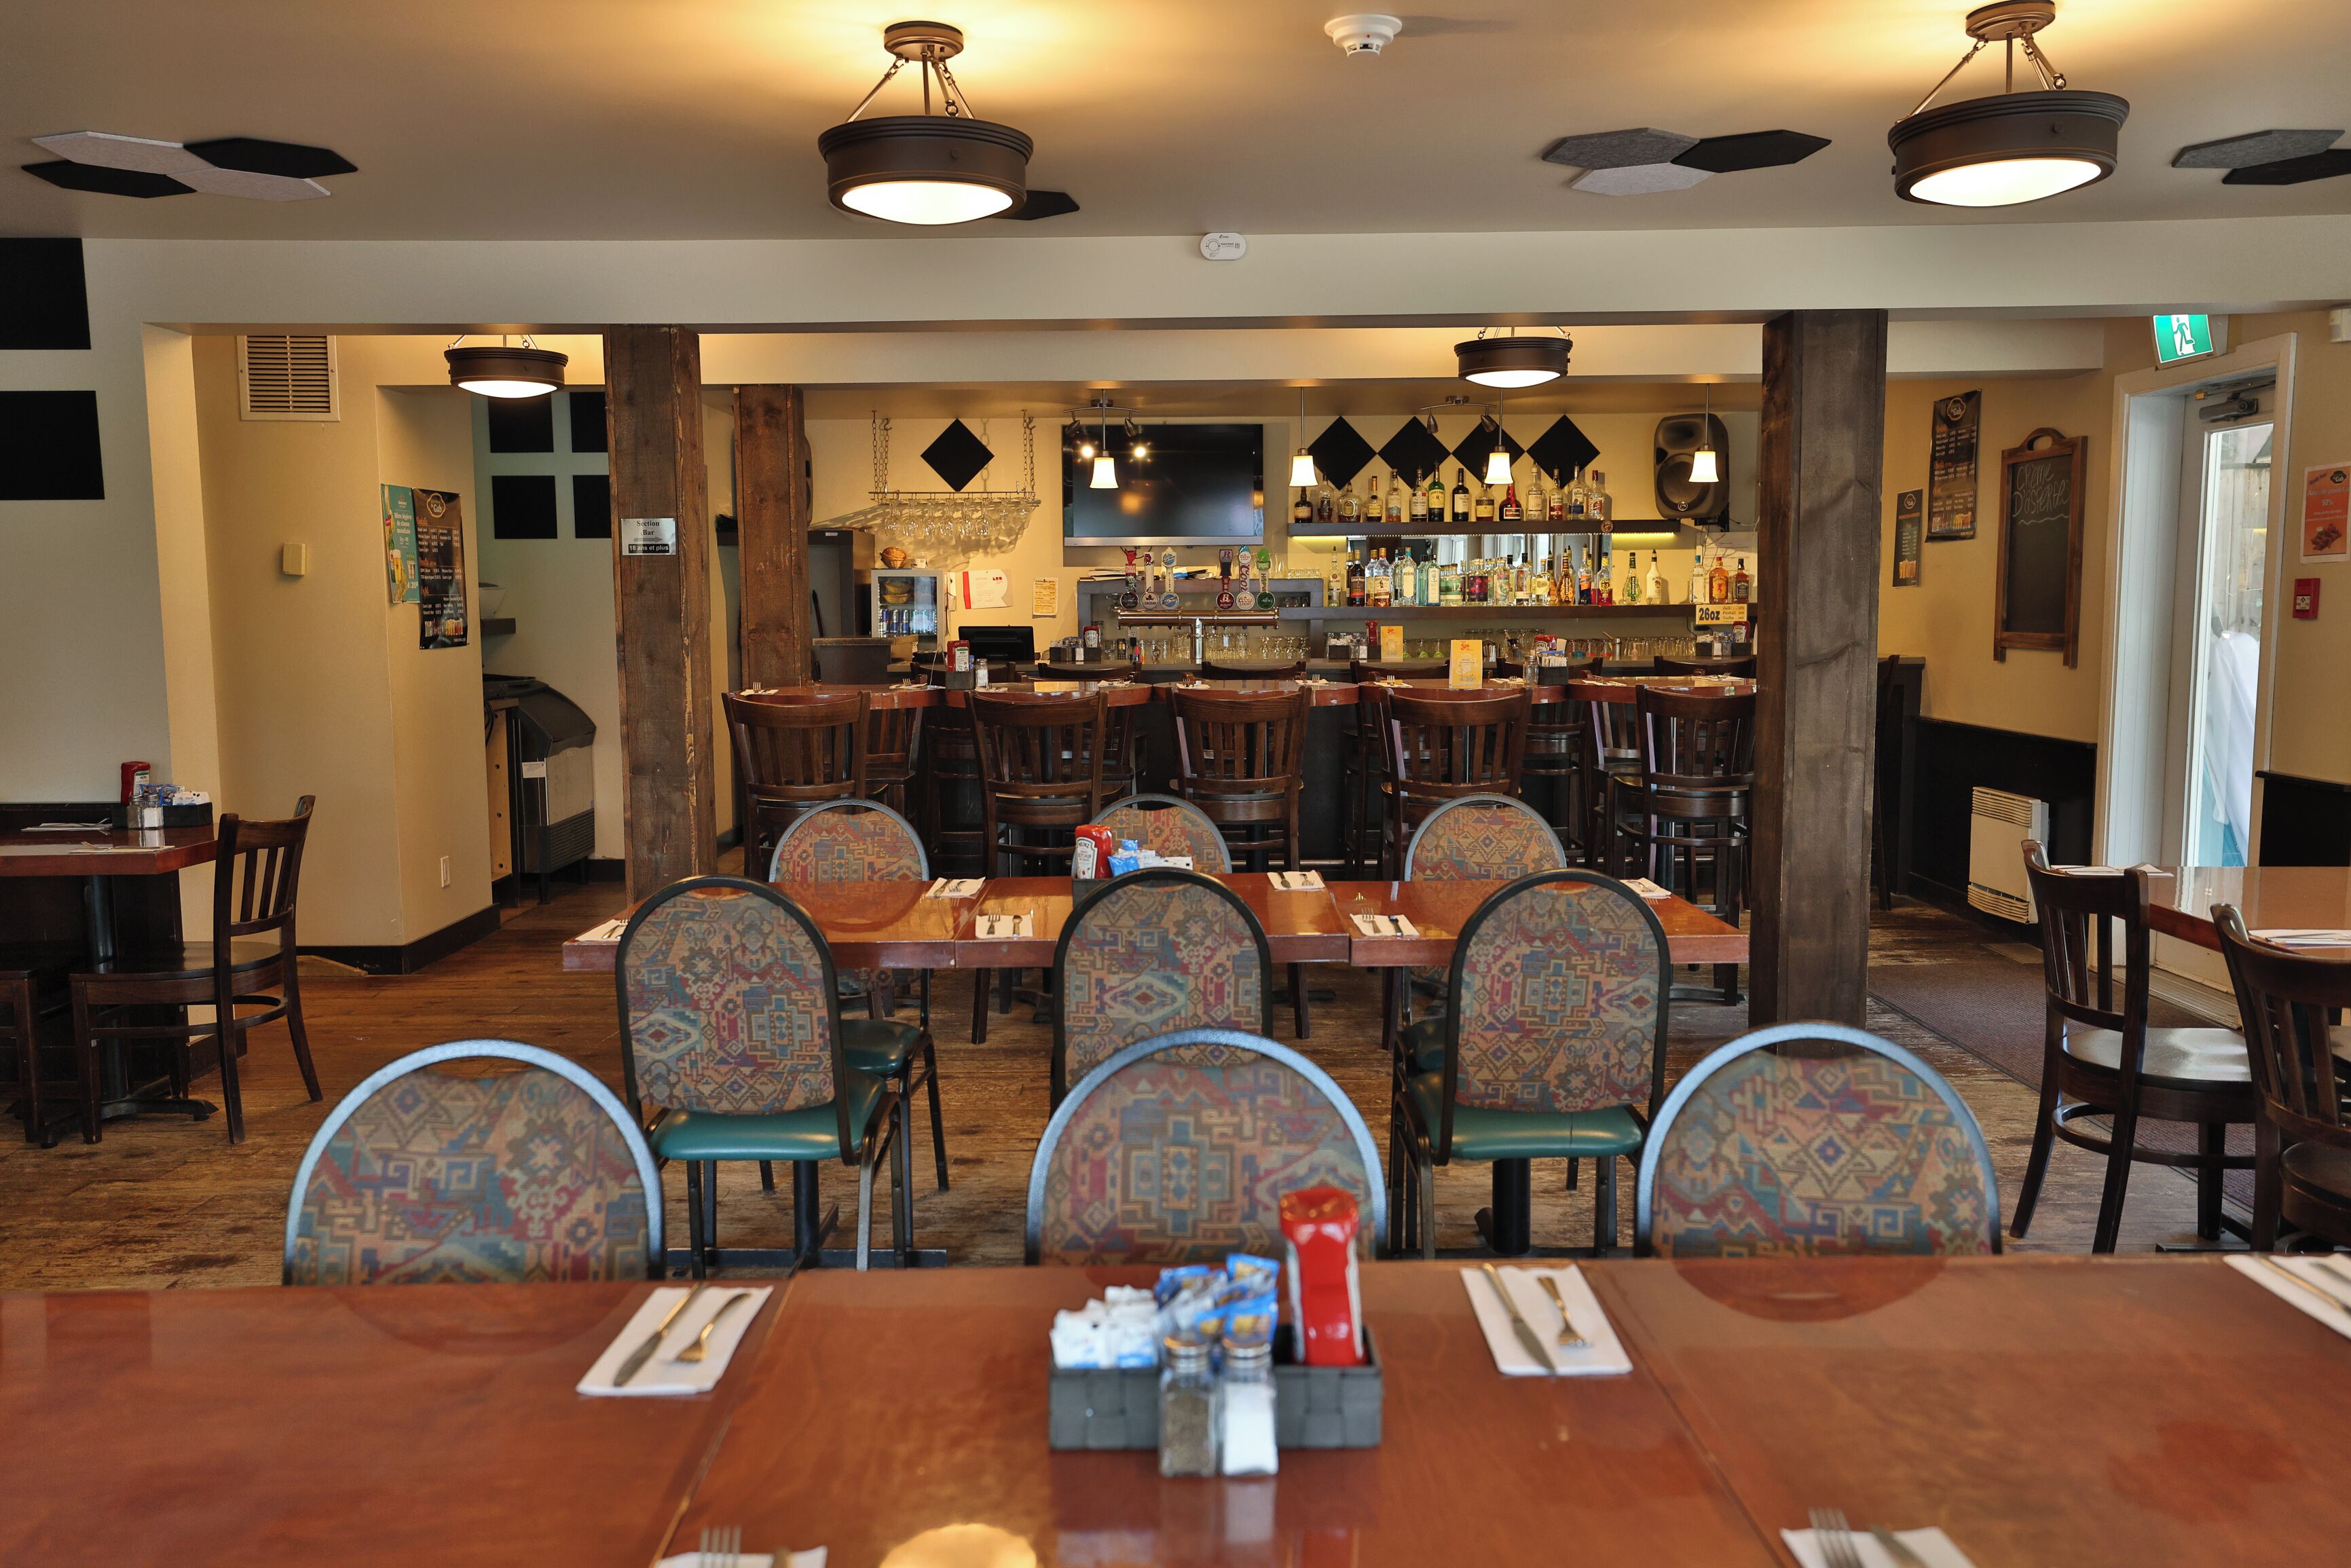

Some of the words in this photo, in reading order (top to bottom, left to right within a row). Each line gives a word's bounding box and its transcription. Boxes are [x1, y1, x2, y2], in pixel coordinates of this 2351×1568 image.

[1953, 407, 1962, 415] Gab
[434, 504, 442, 512] Gab
[1453, 583, 1461, 591] 12
[1699, 608, 1720, 621] 26oz
